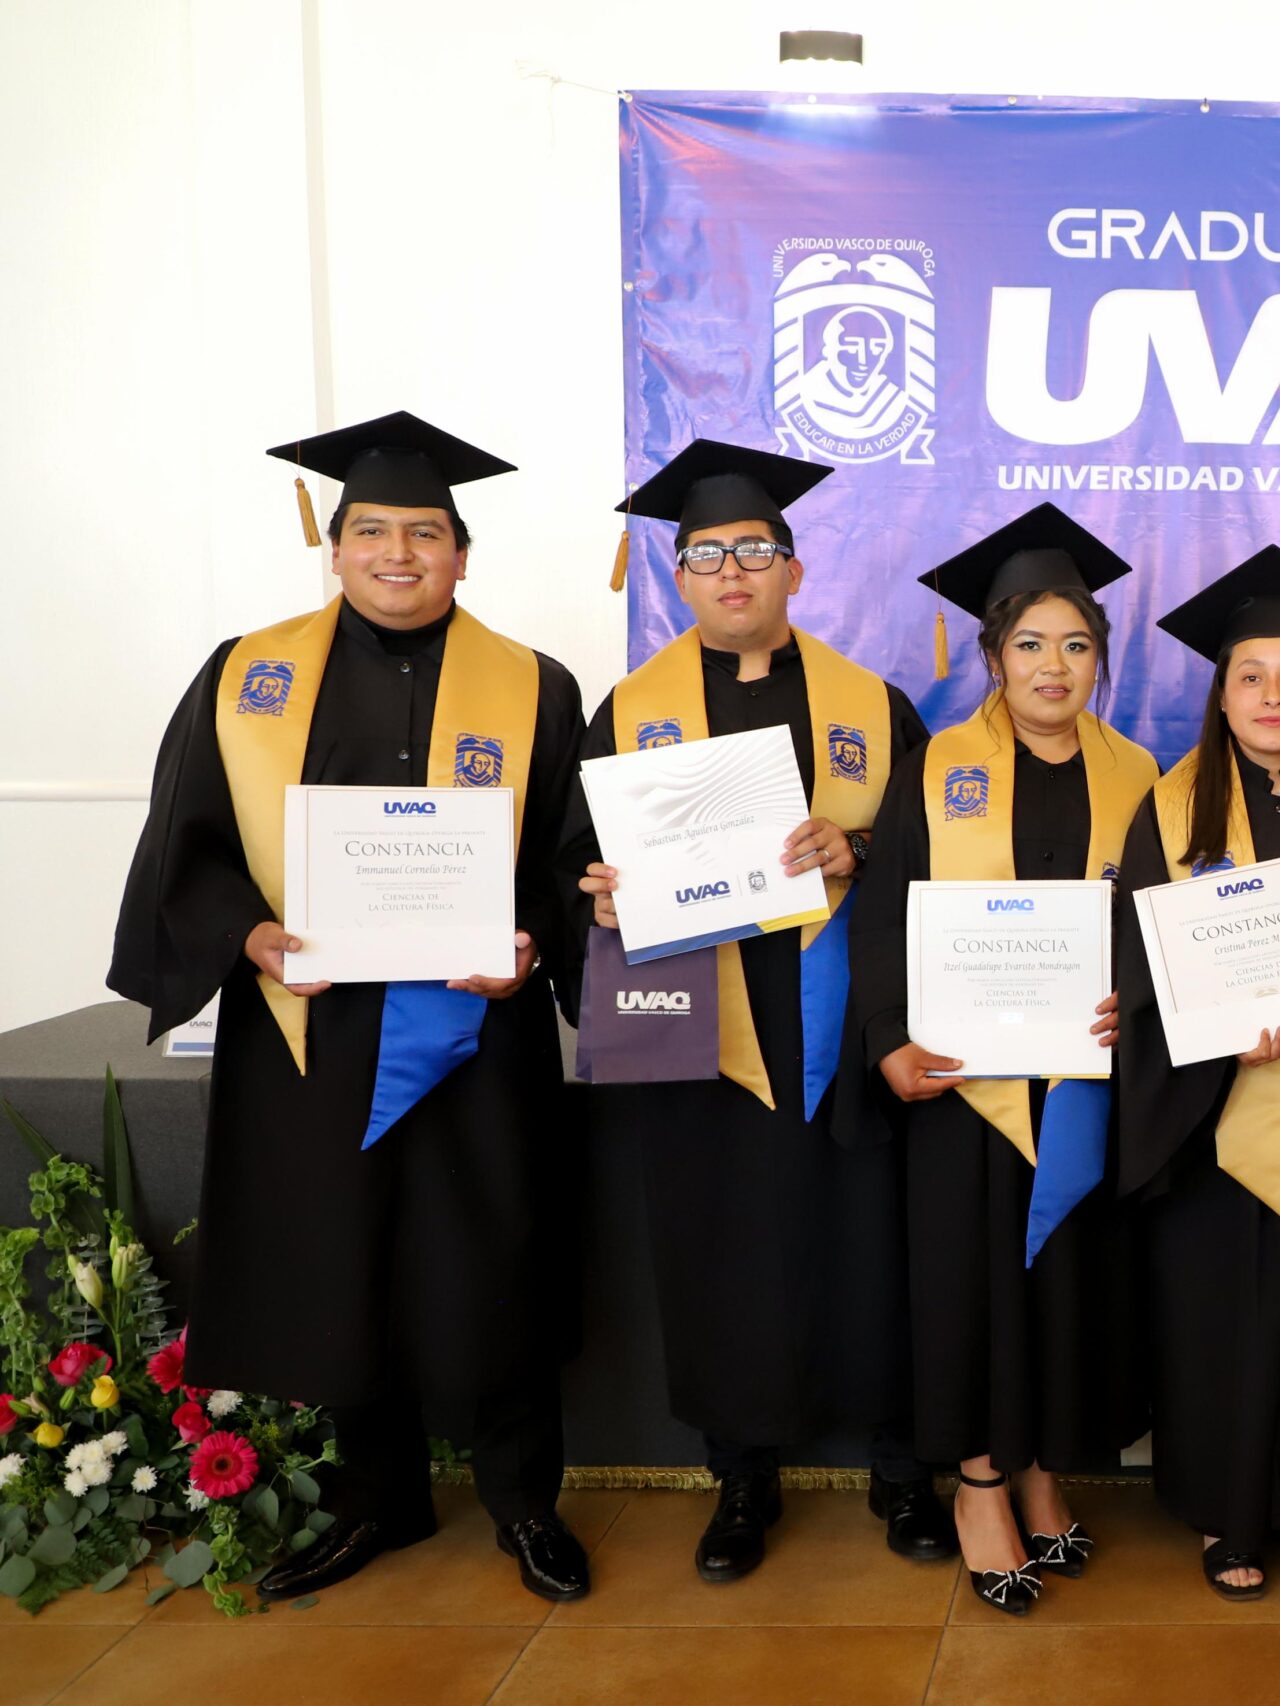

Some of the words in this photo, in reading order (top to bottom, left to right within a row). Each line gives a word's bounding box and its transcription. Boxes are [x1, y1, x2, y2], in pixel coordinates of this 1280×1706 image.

[773, 238, 834, 278] UNIVERSIDAD
[835, 238, 875, 250] VASCO
[876, 239, 893, 250] DE
[894, 238, 936, 278] QUIROGA
[793, 411, 836, 452] EDUCAR
[837, 443, 855, 455] EN
[858, 445, 874, 455] LA
[875, 411, 916, 451] VERDAD
[998, 464, 1245, 492] UNIVERSIDAD
[384, 801, 437, 814] UVAQ
[684, 822, 719, 841] Aguilera
[345, 840, 475, 857] CONSTANCIA
[355, 864, 403, 875] Emmanuel
[404, 863, 441, 875] Cornelio
[675, 880, 731, 905] UVAQ
[1216, 878, 1265, 898] UVAQ
[986, 898, 1035, 912] UVAQ
[952, 937, 1069, 954] CONSTANCIA
[1213, 940, 1246, 956] Cristina
[943, 960, 961, 972] Itzel
[962, 960, 1002, 974] Guadalupe
[1004, 960, 1036, 972] Evaristo
[615, 990, 692, 1011] UVAQ
